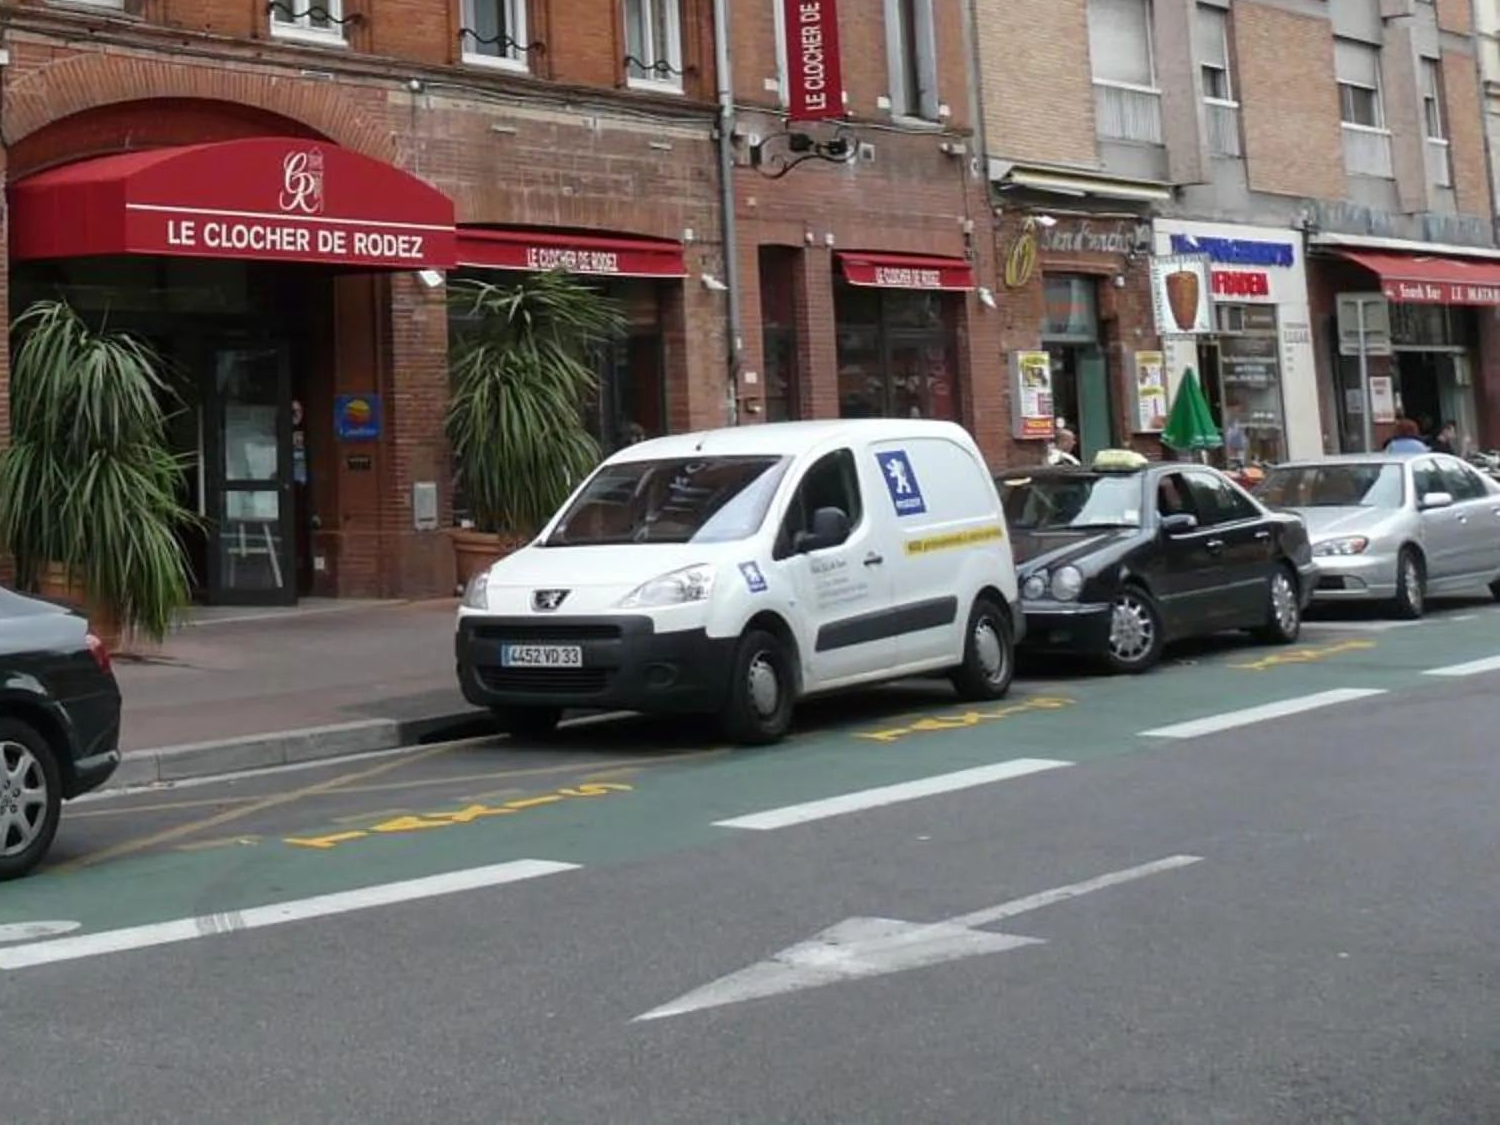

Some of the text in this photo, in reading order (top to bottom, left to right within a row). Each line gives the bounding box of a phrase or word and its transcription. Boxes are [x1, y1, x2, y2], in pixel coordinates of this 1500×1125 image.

[800, 2, 821, 22] DE
[802, 25, 825, 90] CLOCHER
[805, 92, 827, 110] LE
[167, 220, 424, 258] LE CLOCHER DE RODEZ
[526, 247, 538, 268] LE
[578, 250, 591, 270] DE
[512, 648, 541, 664] 4452
[562, 649, 579, 664] 33
